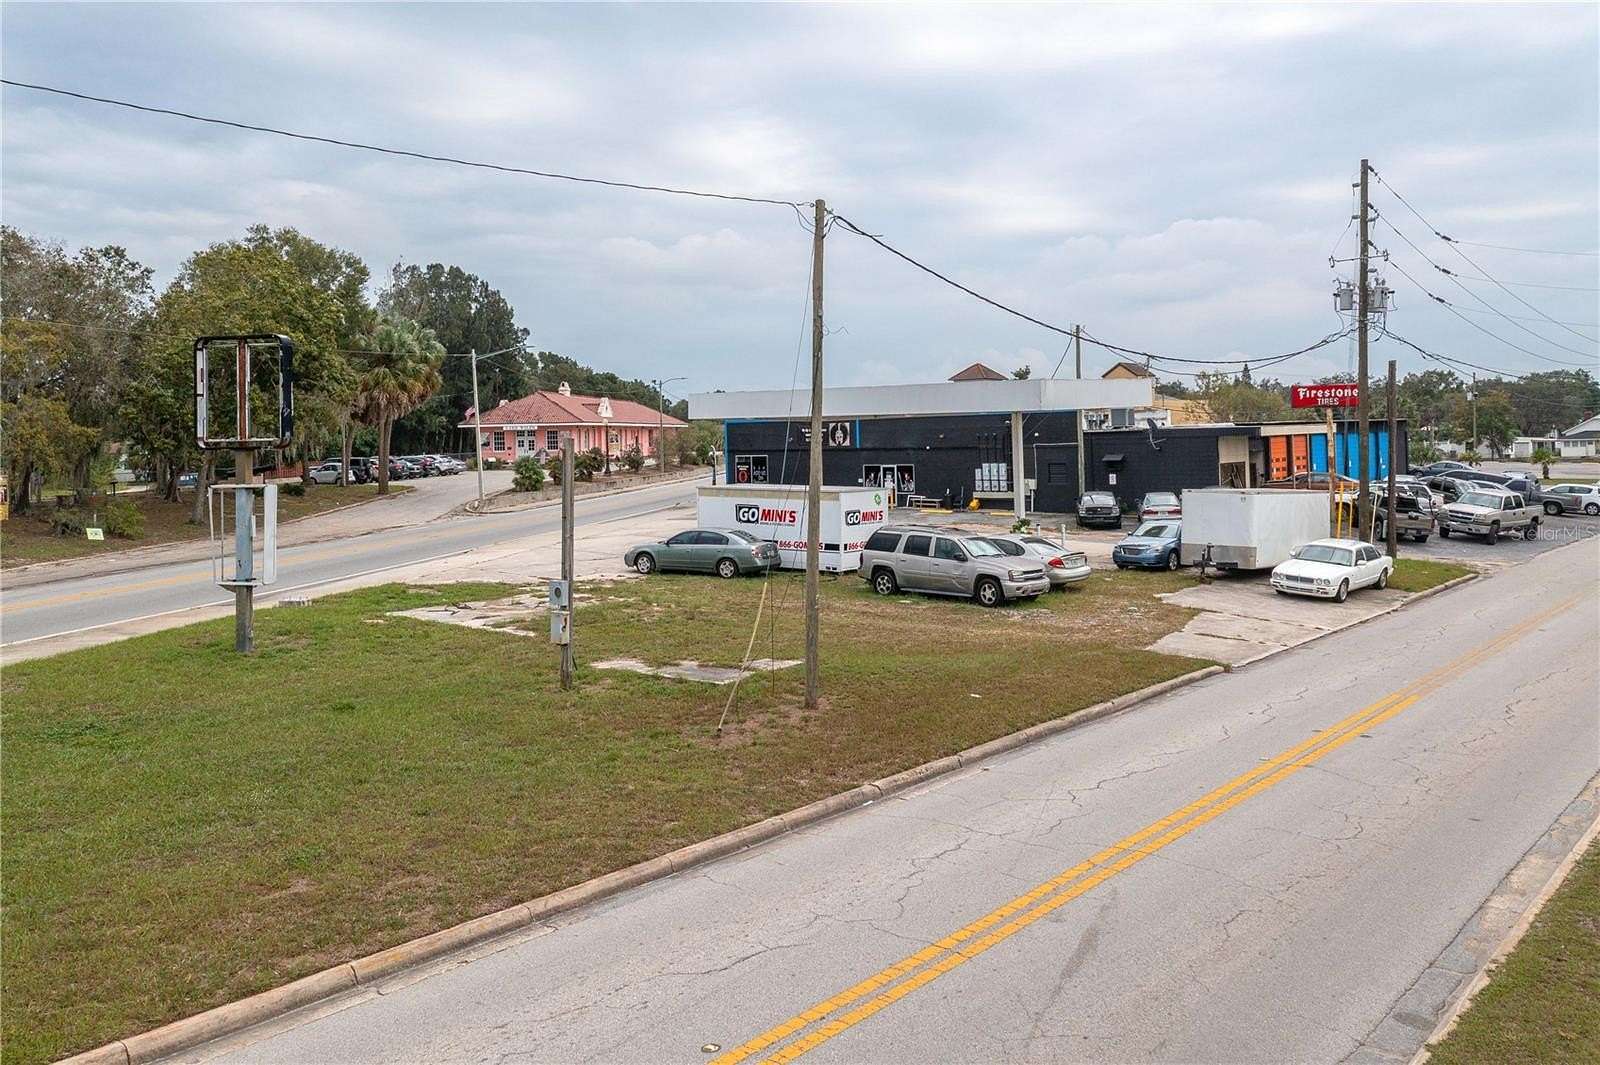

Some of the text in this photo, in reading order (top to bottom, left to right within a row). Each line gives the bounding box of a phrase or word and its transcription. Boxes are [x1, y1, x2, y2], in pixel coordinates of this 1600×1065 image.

[1297, 387, 1359, 400] Firestone
[1317, 397, 1339, 405] TIRES
[739, 508, 797, 523] GO MINI'S
[847, 512, 860, 524] GO
[861, 510, 884, 522] MINI'S
